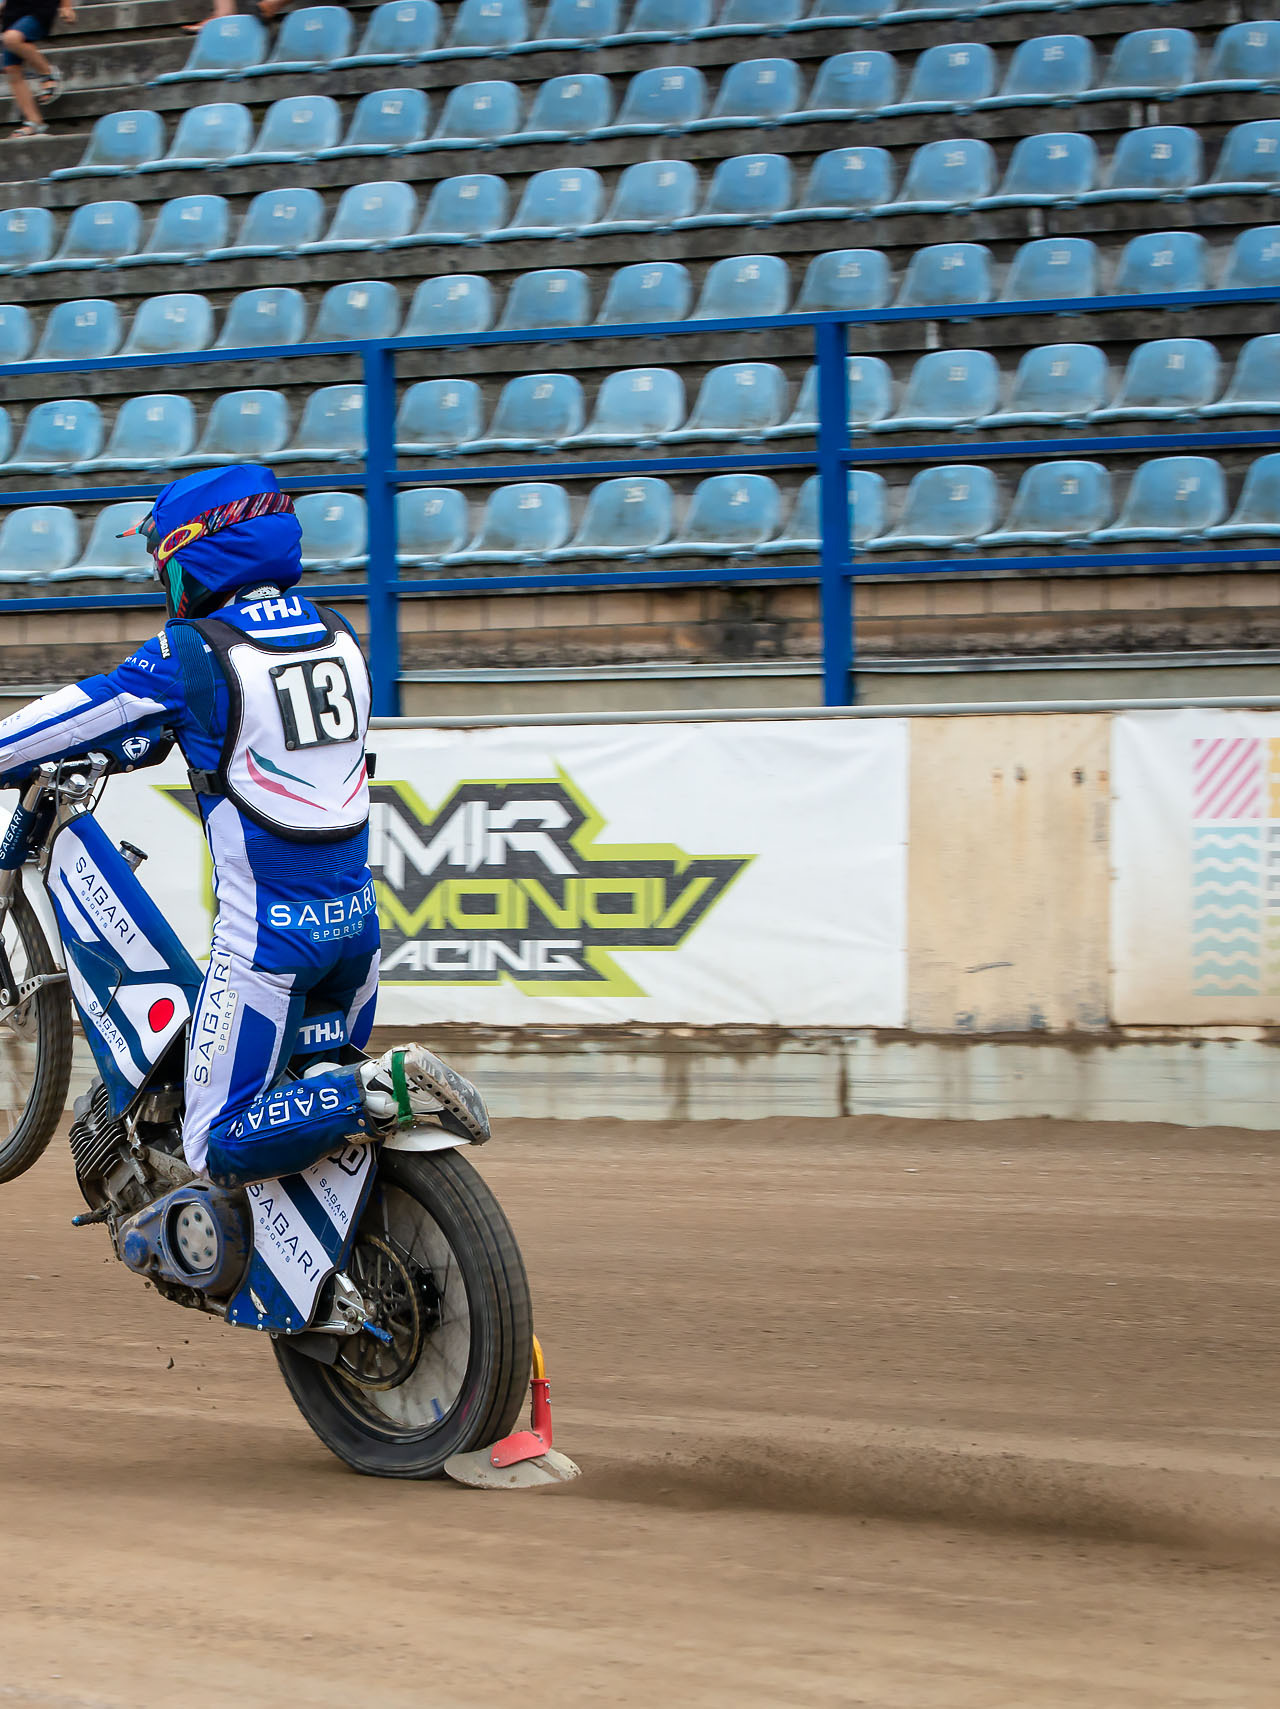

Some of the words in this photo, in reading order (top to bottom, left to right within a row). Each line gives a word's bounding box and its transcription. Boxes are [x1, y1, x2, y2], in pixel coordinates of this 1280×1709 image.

[273, 660, 356, 746] 13
[0, 808, 24, 860] SAGARI
[75, 856, 137, 945] SAGARI
[80, 890, 109, 929] SPORTS
[270, 880, 376, 927] SAGARI
[312, 920, 363, 940] SPORTS
[378, 939, 587, 972] ACING
[193, 951, 232, 1084] SAGARI
[217, 991, 237, 1054] SPORTS
[319, 1177, 349, 1225] SAGARI
[248, 1183, 321, 1282] SAGARI
[259, 1217, 292, 1264] SPORTS
